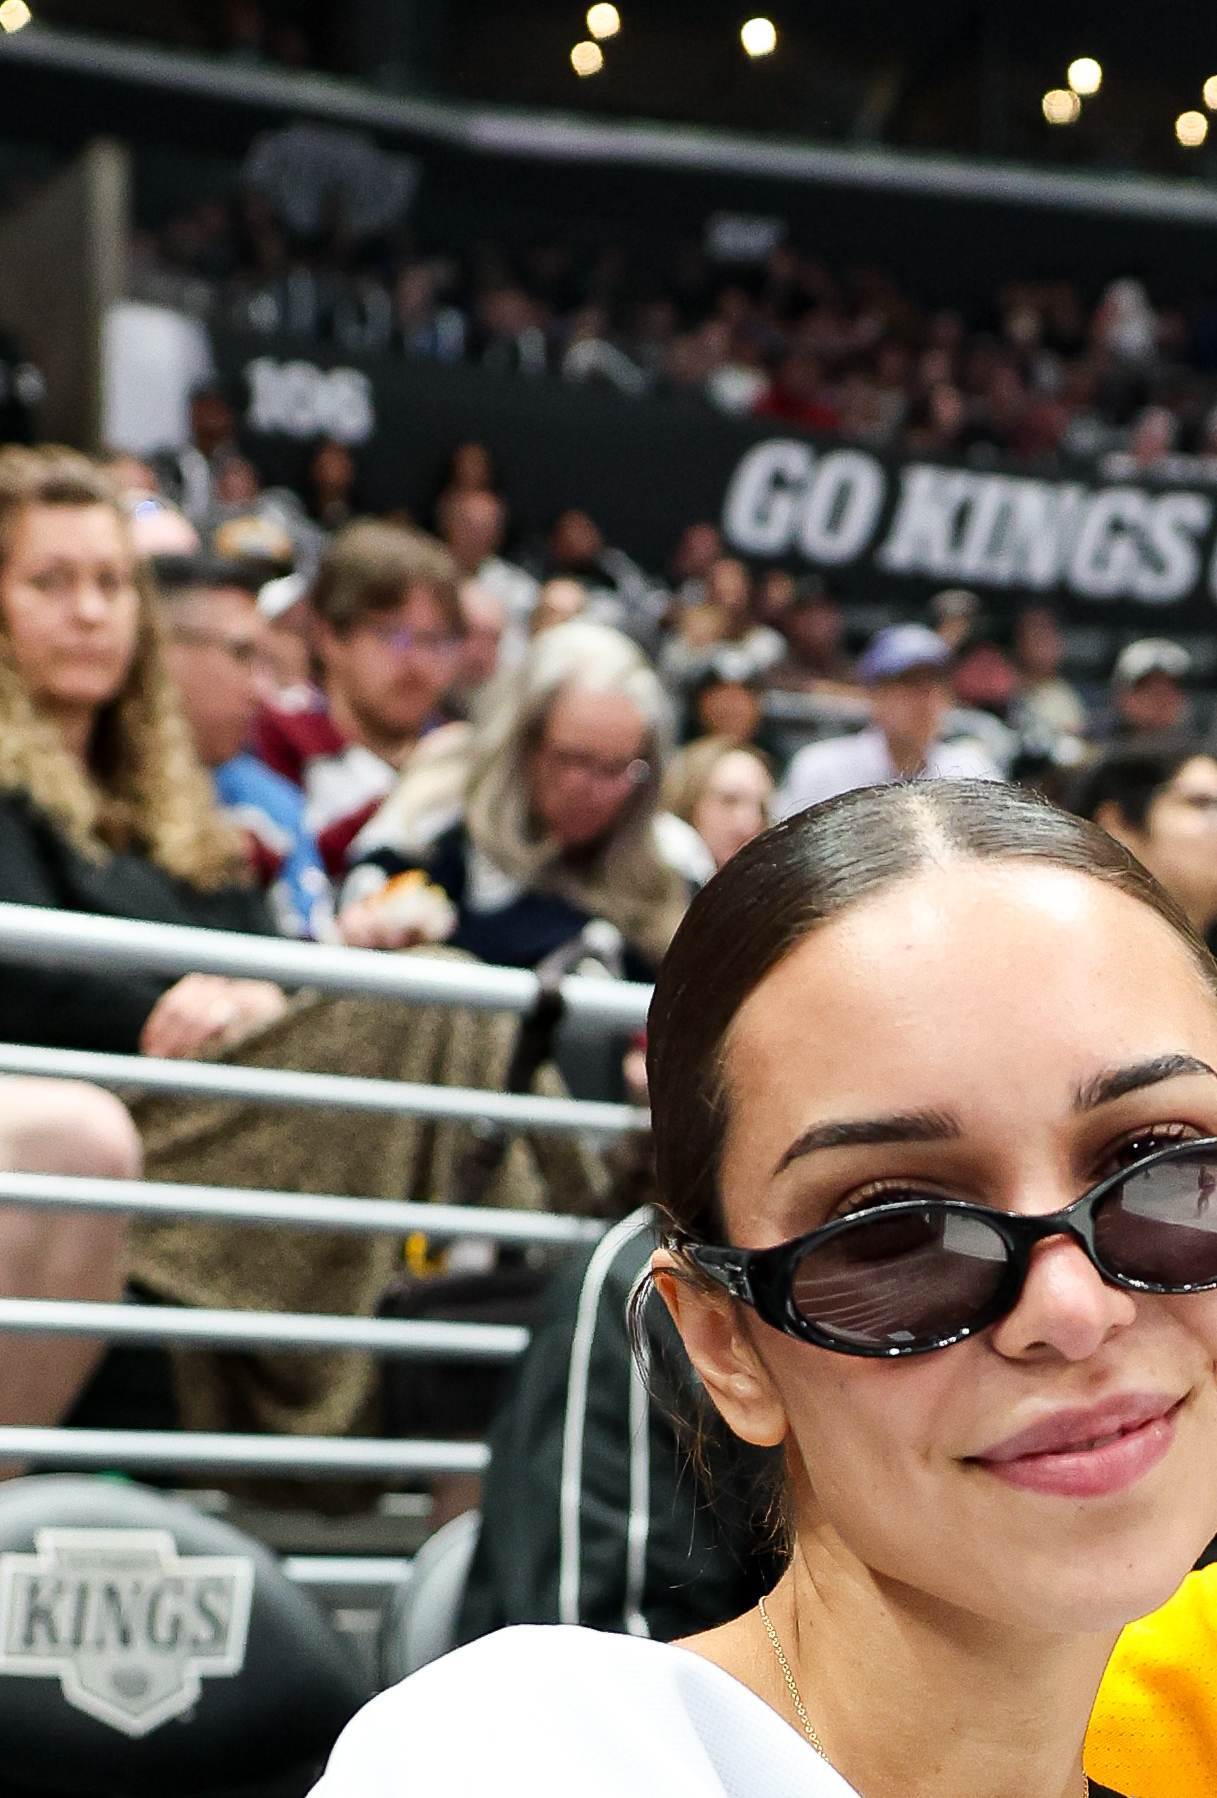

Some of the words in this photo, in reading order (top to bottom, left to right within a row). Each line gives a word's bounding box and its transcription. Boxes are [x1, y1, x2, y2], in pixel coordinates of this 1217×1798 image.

[727, 439, 880, 563] GO
[880, 463, 1208, 600] KINGS
[22, 1577, 230, 1651] KINGS
